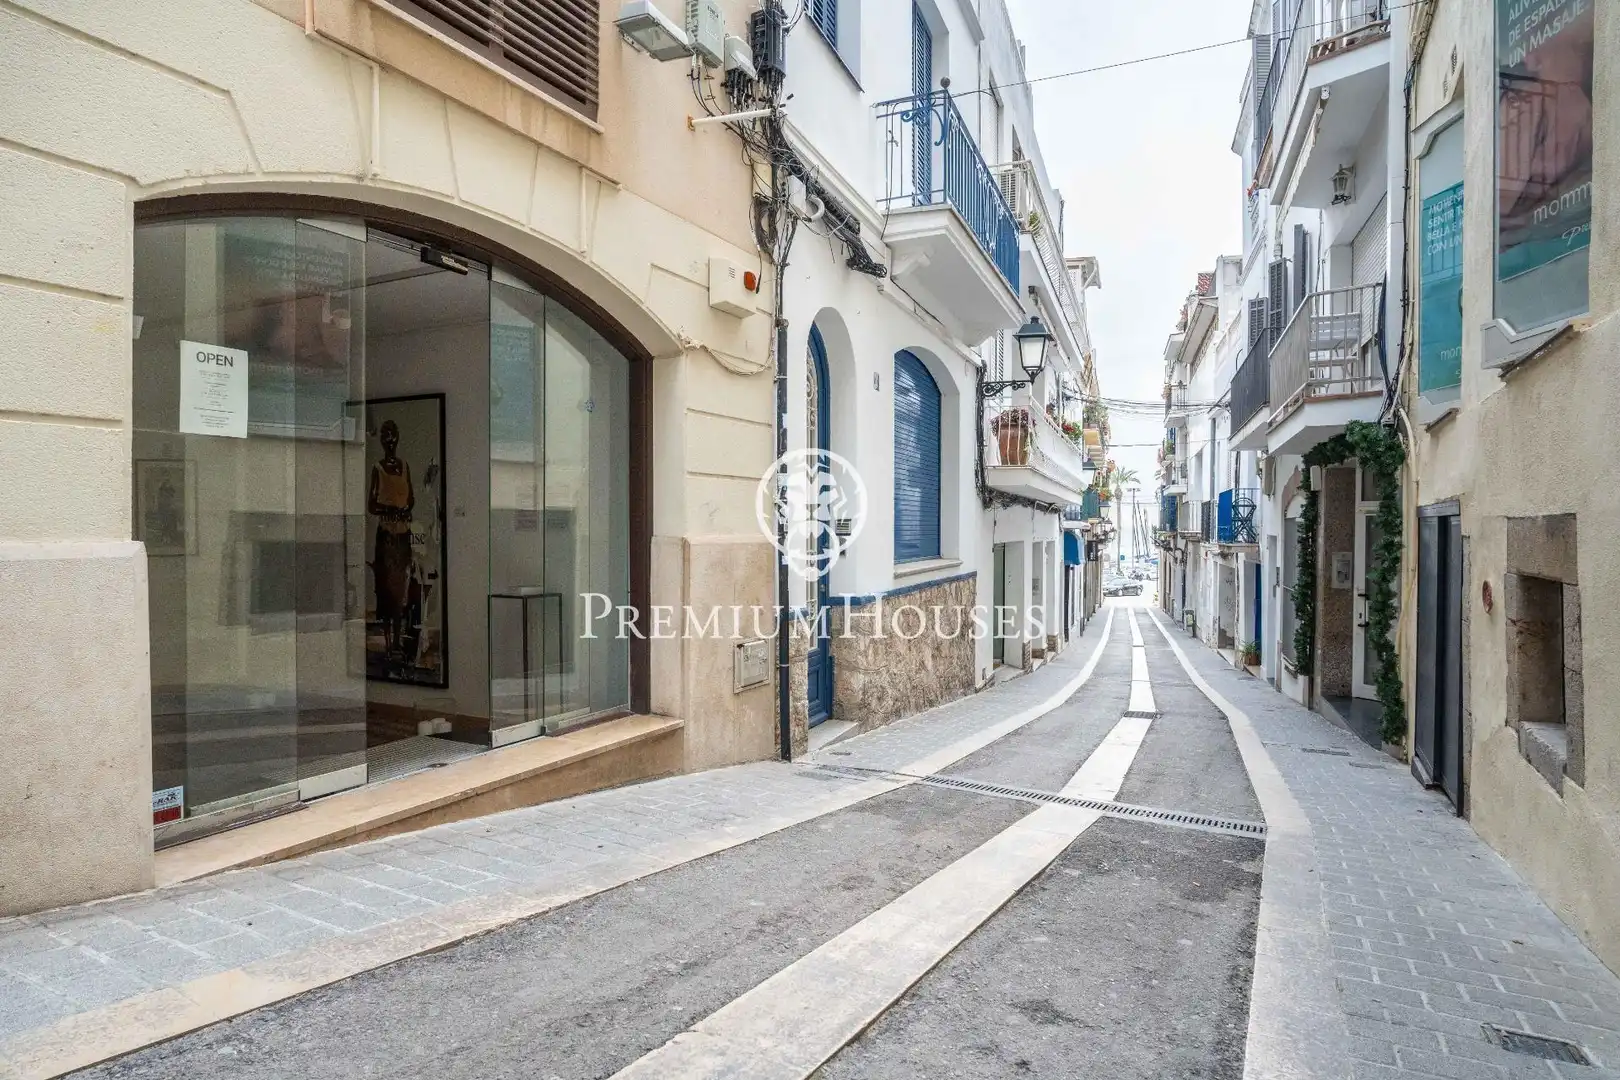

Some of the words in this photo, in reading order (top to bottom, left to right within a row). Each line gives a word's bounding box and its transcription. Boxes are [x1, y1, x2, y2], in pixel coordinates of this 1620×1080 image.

[1508, 23, 1521, 48] DE
[1508, 41, 1526, 68] UN
[1427, 239, 1447, 256] CON
[196, 351, 234, 367] OPEN
